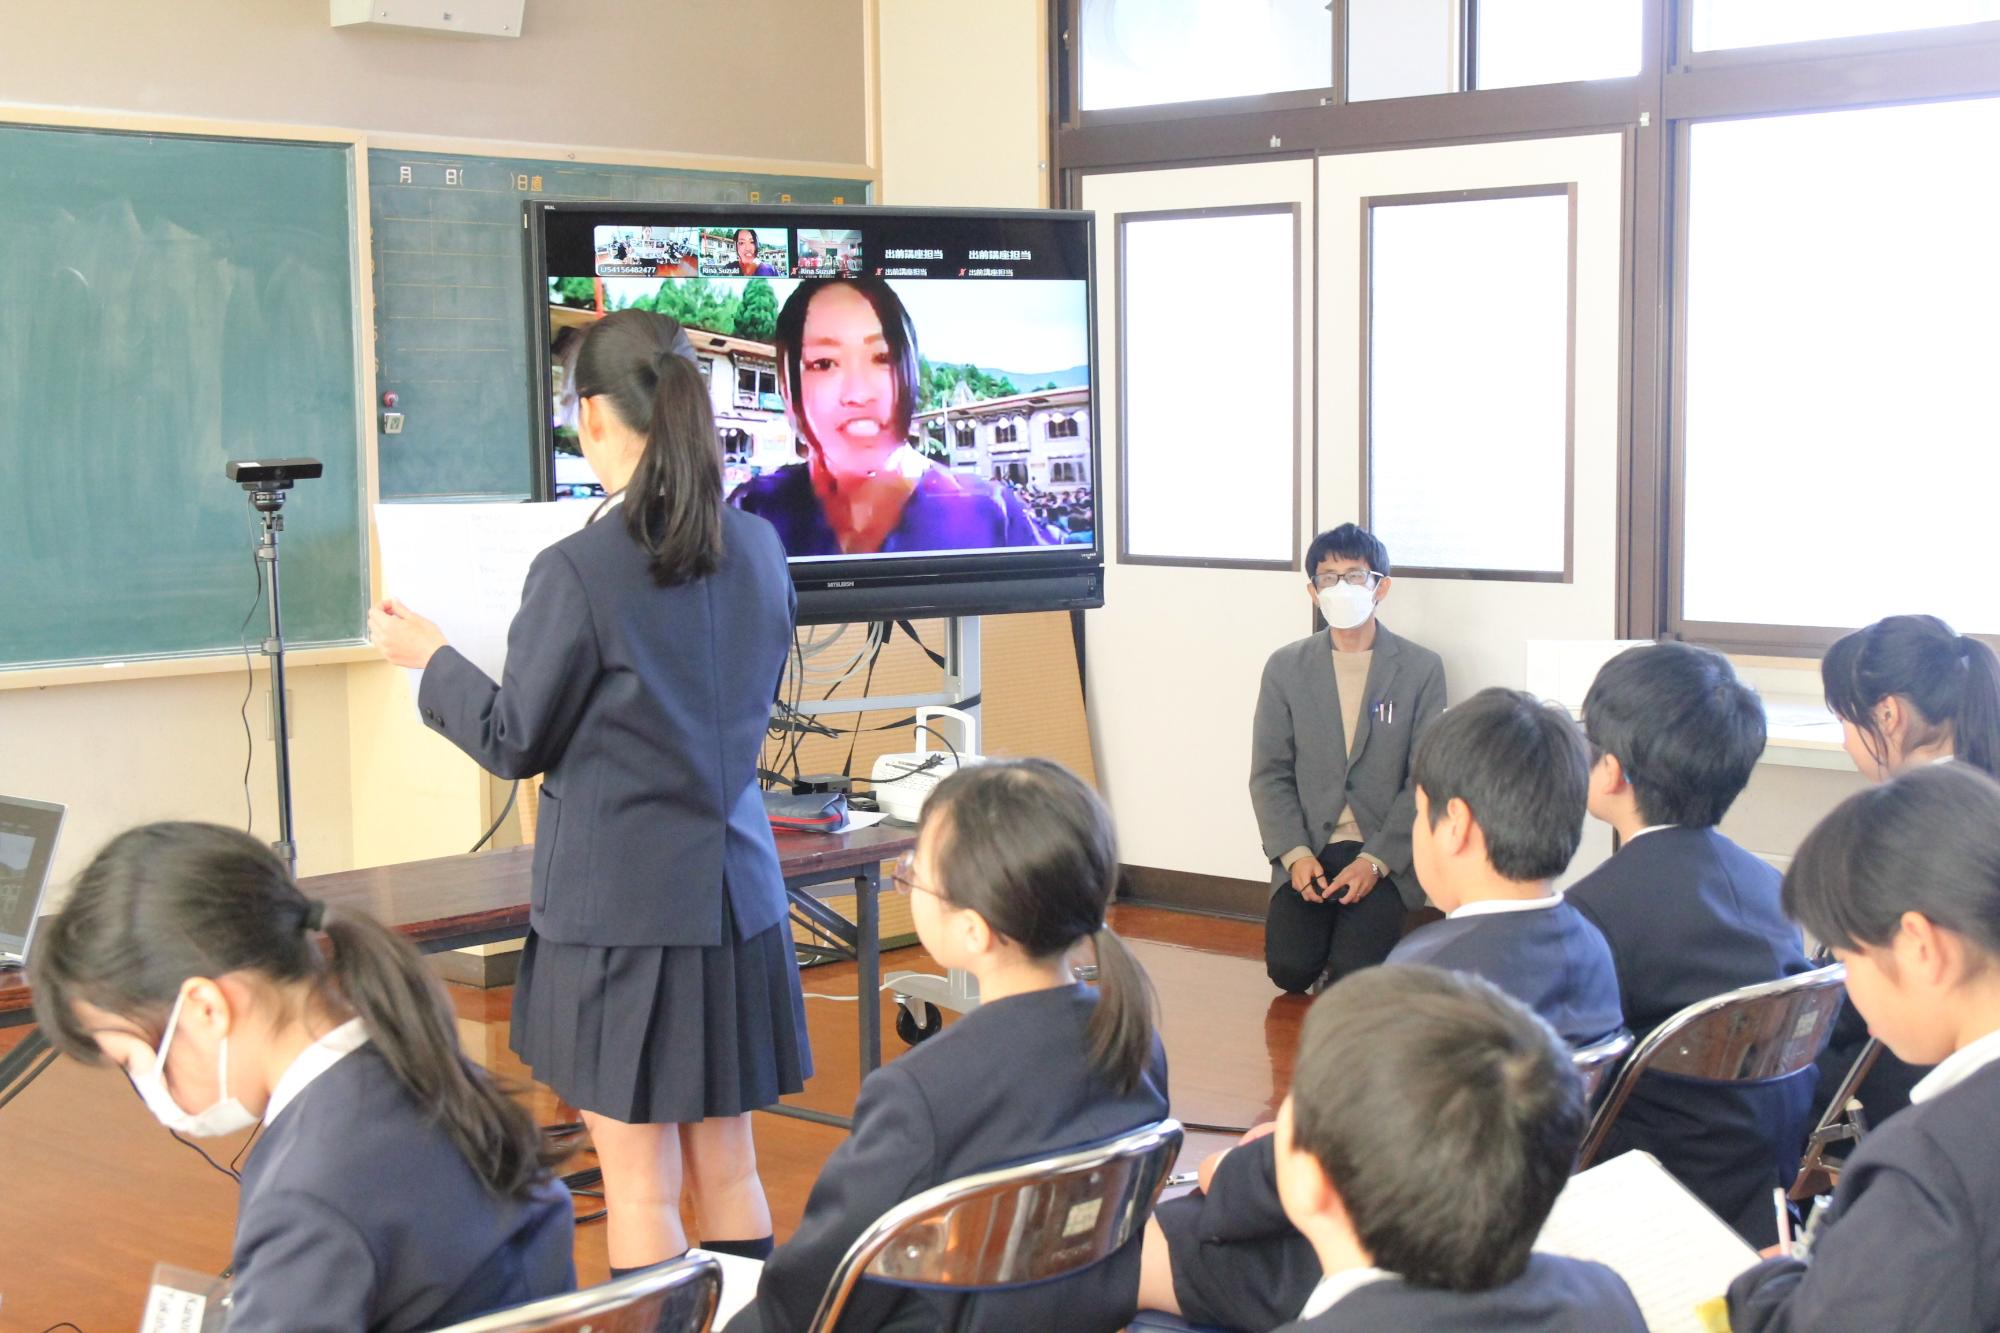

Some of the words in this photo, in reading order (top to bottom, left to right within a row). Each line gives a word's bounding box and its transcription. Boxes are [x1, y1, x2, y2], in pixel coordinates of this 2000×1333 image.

[400, 166, 411, 184] 月
[885, 249, 944, 260] 出前講座担当
[968, 250, 1032, 261] 出前講座担当
[702, 267, 717, 275] Rina
[718, 267, 740, 275] Suzuki
